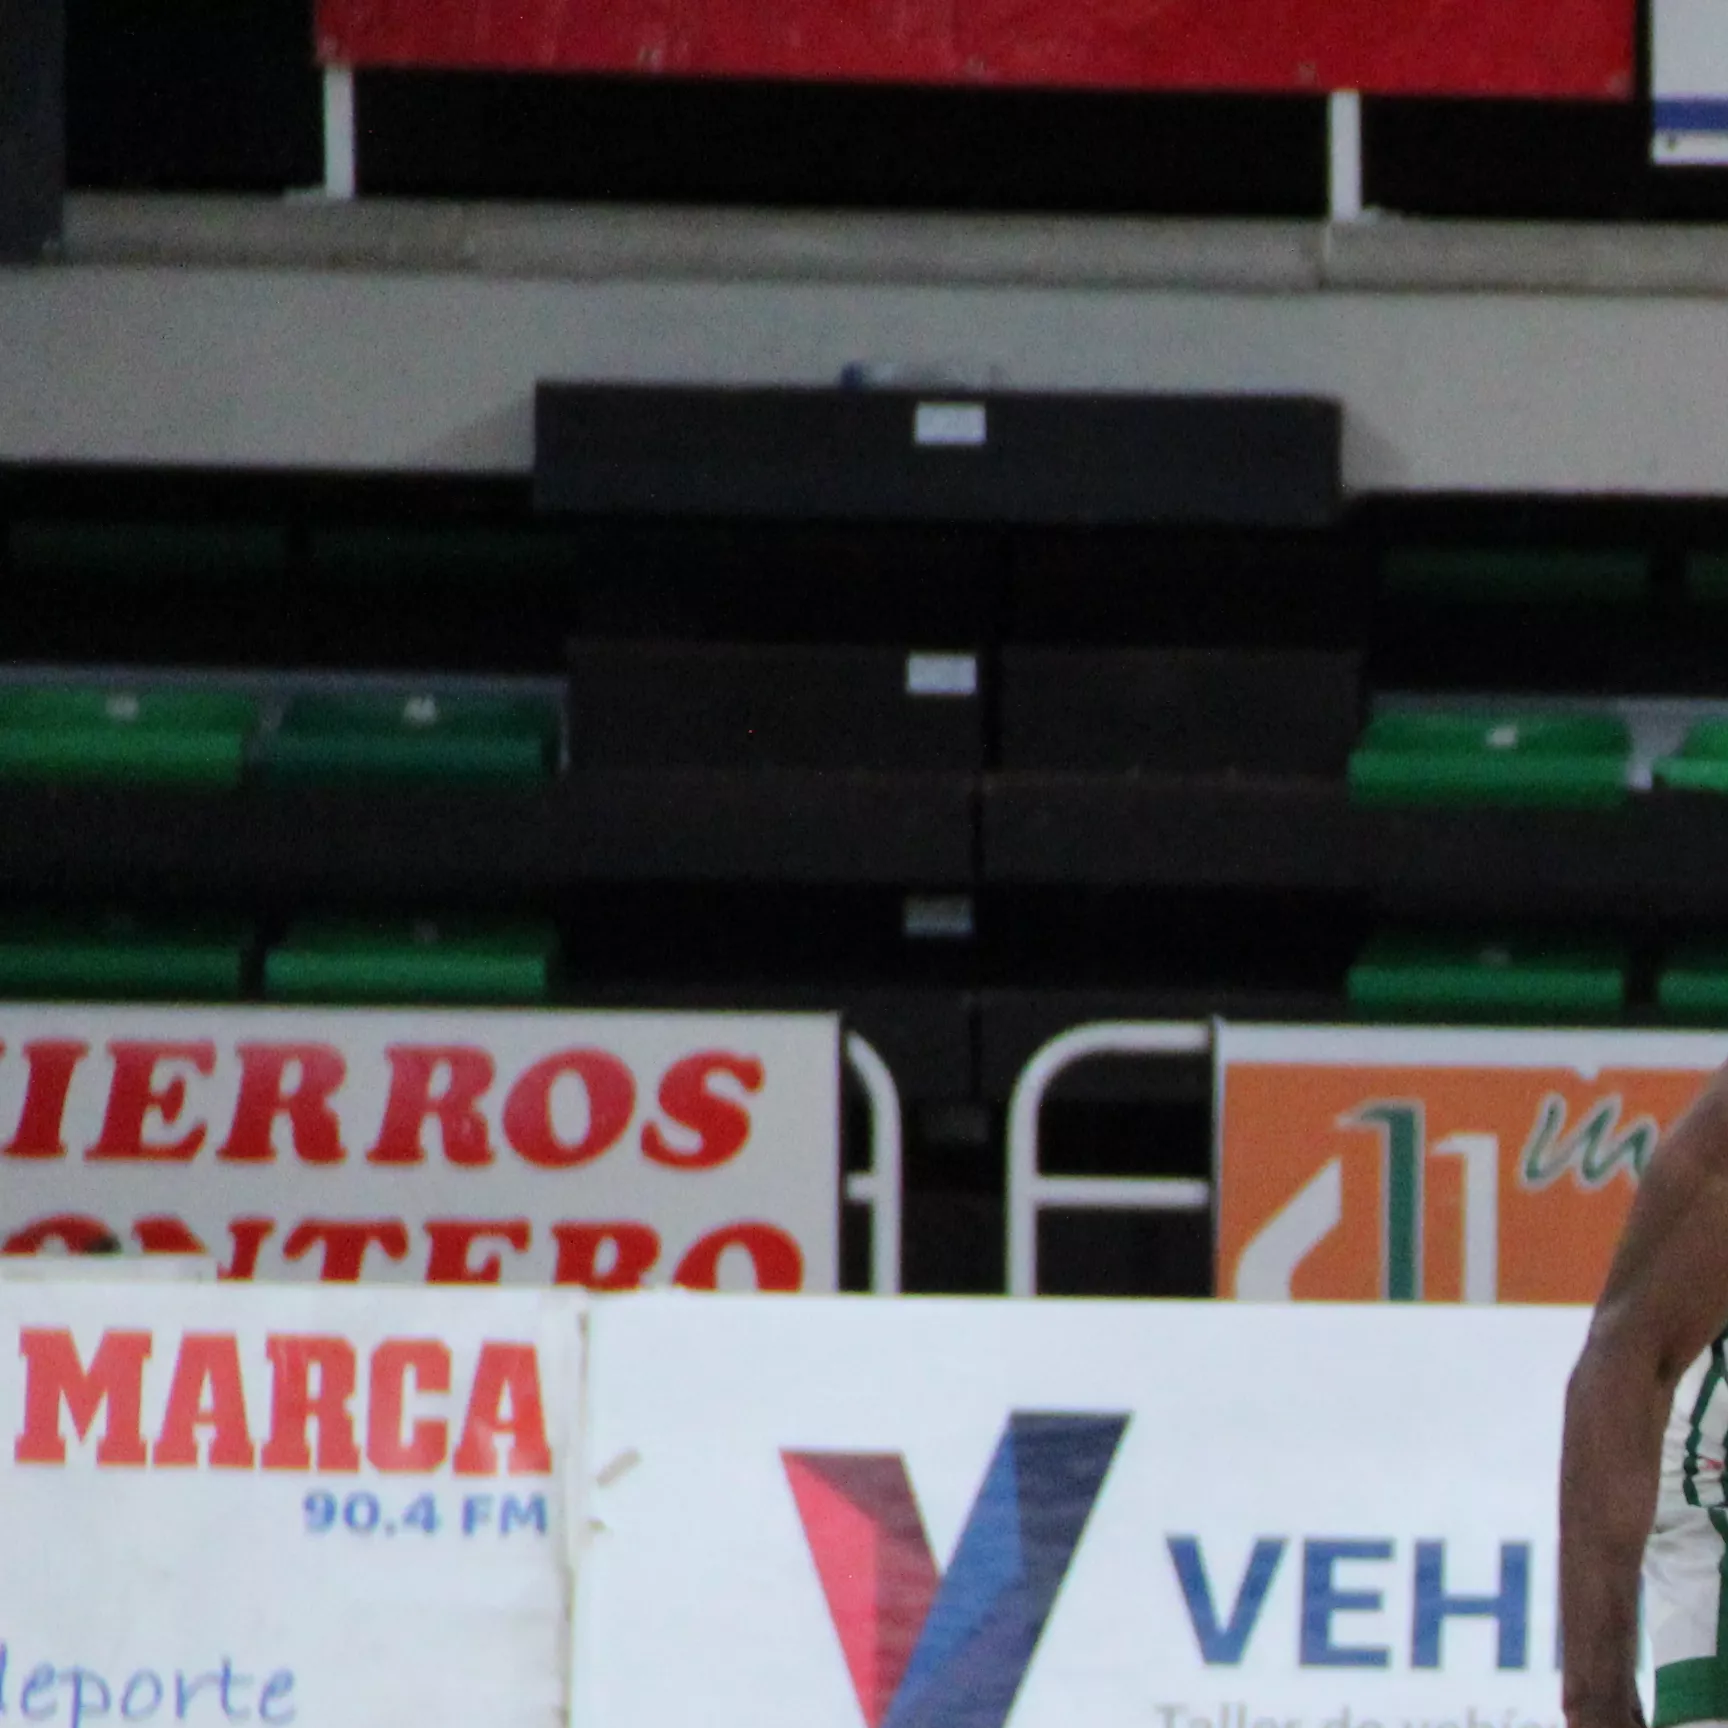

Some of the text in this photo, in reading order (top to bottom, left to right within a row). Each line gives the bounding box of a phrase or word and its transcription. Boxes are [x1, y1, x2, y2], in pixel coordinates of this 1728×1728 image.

[0, 1040, 765, 1171] IERROS
[14, 1326, 553, 1477] MARCA
[303, 1491, 548, 1537] 90.4 FM
[1165, 1534, 1567, 1672] VEH
